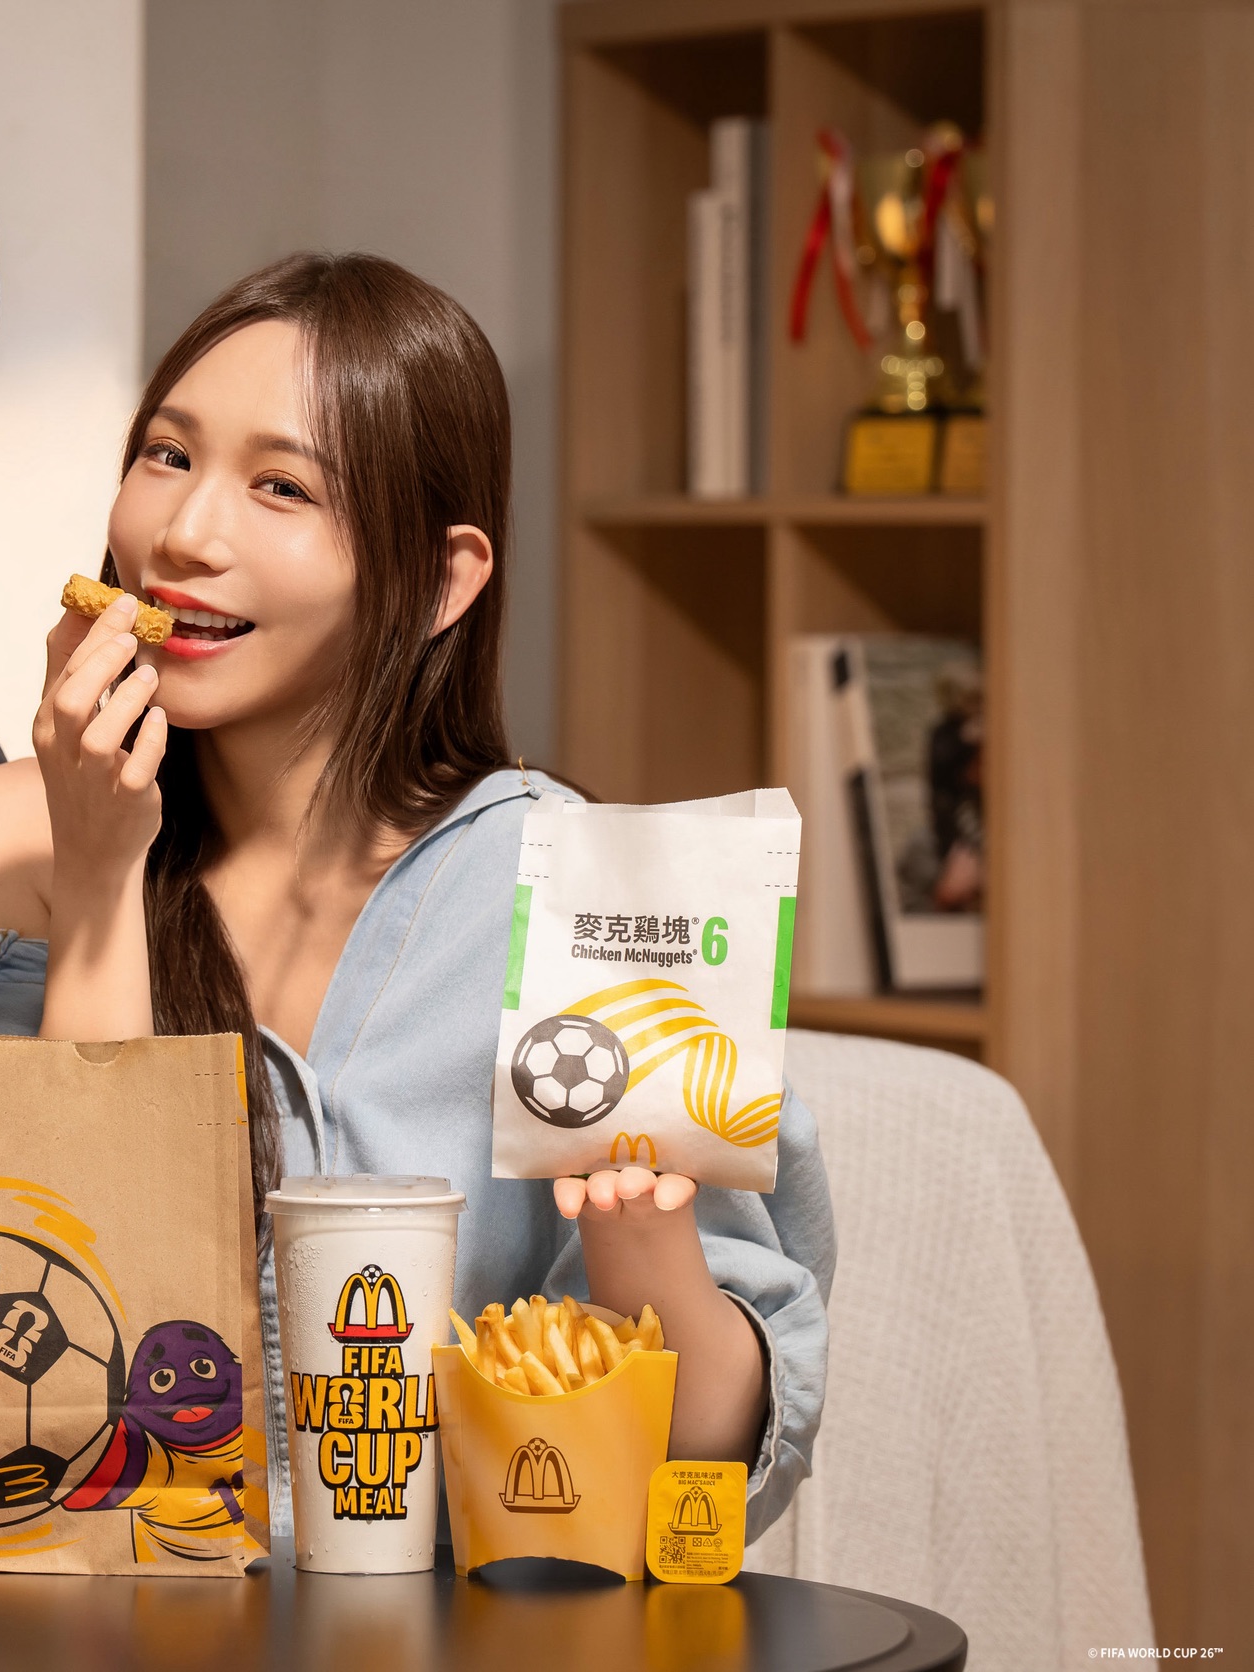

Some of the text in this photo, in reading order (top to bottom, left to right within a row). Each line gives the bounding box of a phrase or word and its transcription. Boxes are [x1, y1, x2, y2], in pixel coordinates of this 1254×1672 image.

[571, 944, 622, 961] Chicken
[701, 916, 729, 966] 6
[343, 1346, 404, 1378] FIFA
[334, 1486, 407, 1520] MEAL
